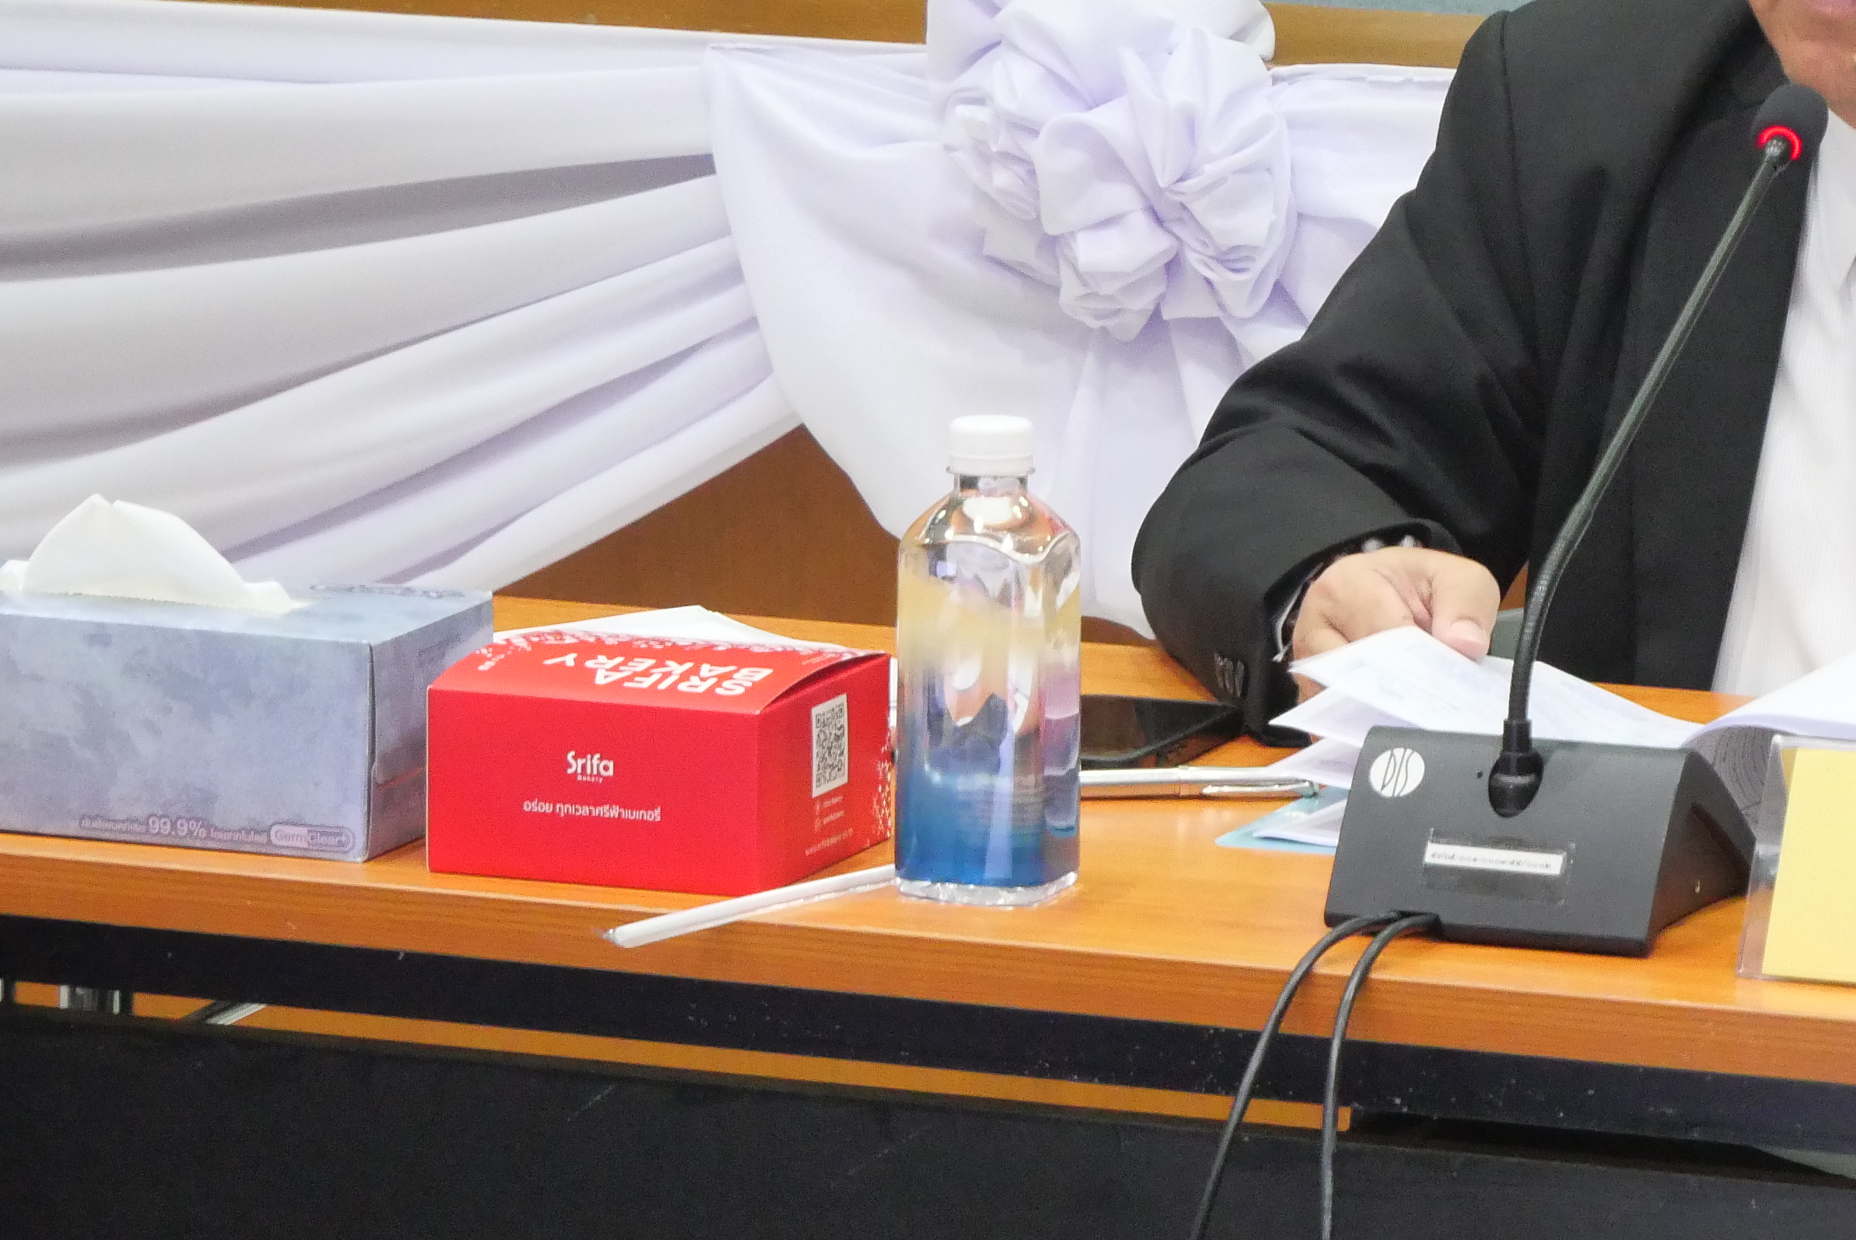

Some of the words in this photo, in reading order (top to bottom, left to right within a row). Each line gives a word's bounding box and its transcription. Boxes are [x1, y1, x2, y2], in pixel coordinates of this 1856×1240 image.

[542, 652, 774, 683] BAKERY
[594, 668, 753, 696] SRIFA
[566, 750, 614, 777] Srifa
[148, 816, 207, 839] 99.9%
